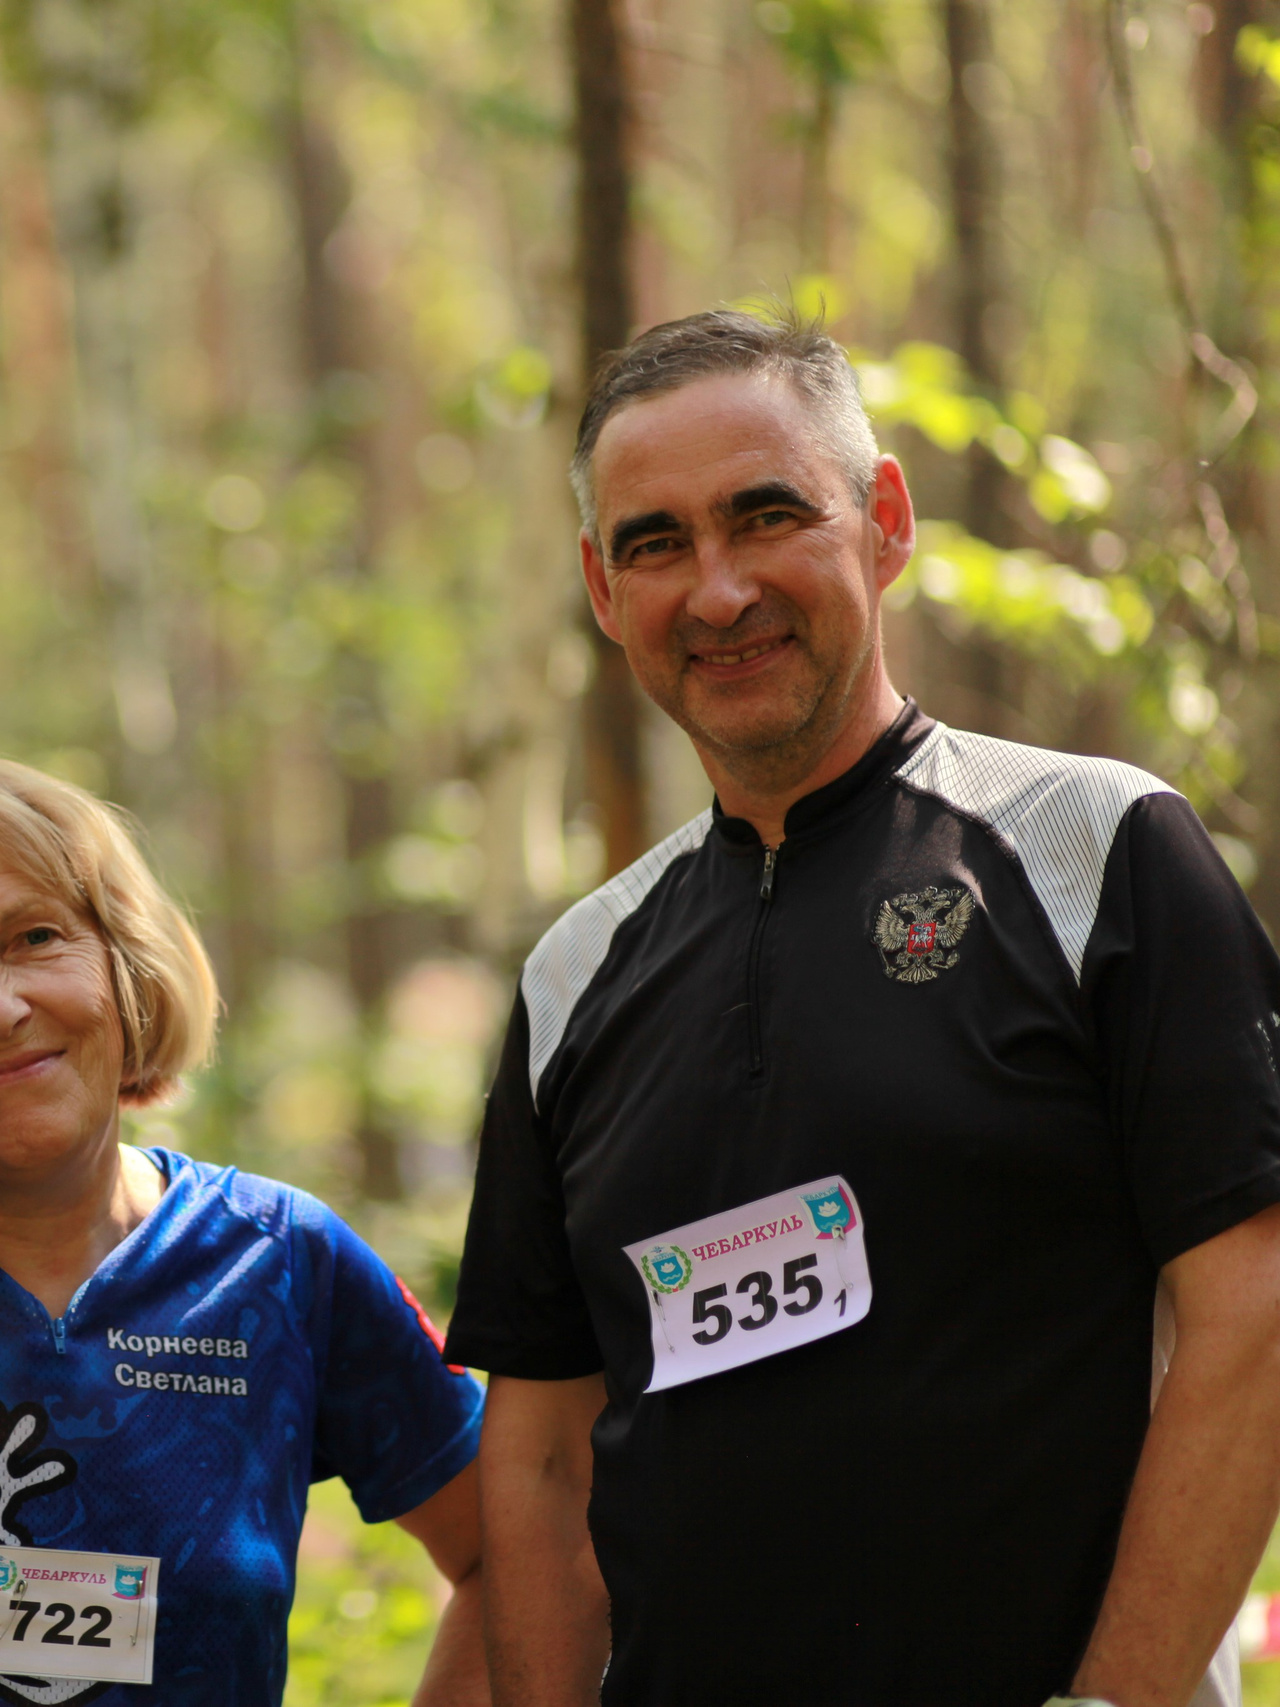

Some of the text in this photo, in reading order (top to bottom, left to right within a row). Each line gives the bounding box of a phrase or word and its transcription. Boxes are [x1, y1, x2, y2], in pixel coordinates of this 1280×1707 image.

[691, 1214, 804, 1261] ЧЕБАРКУЛЬ
[691, 1253, 824, 1346] 535
[833, 1288, 847, 1318] 1
[107, 1327, 248, 1358] Корнеева
[114, 1363, 248, 1396] Светлана
[21, 1567, 107, 1584] ЧЕБАРКУЛЬ
[9, 1599, 113, 1648] 722
